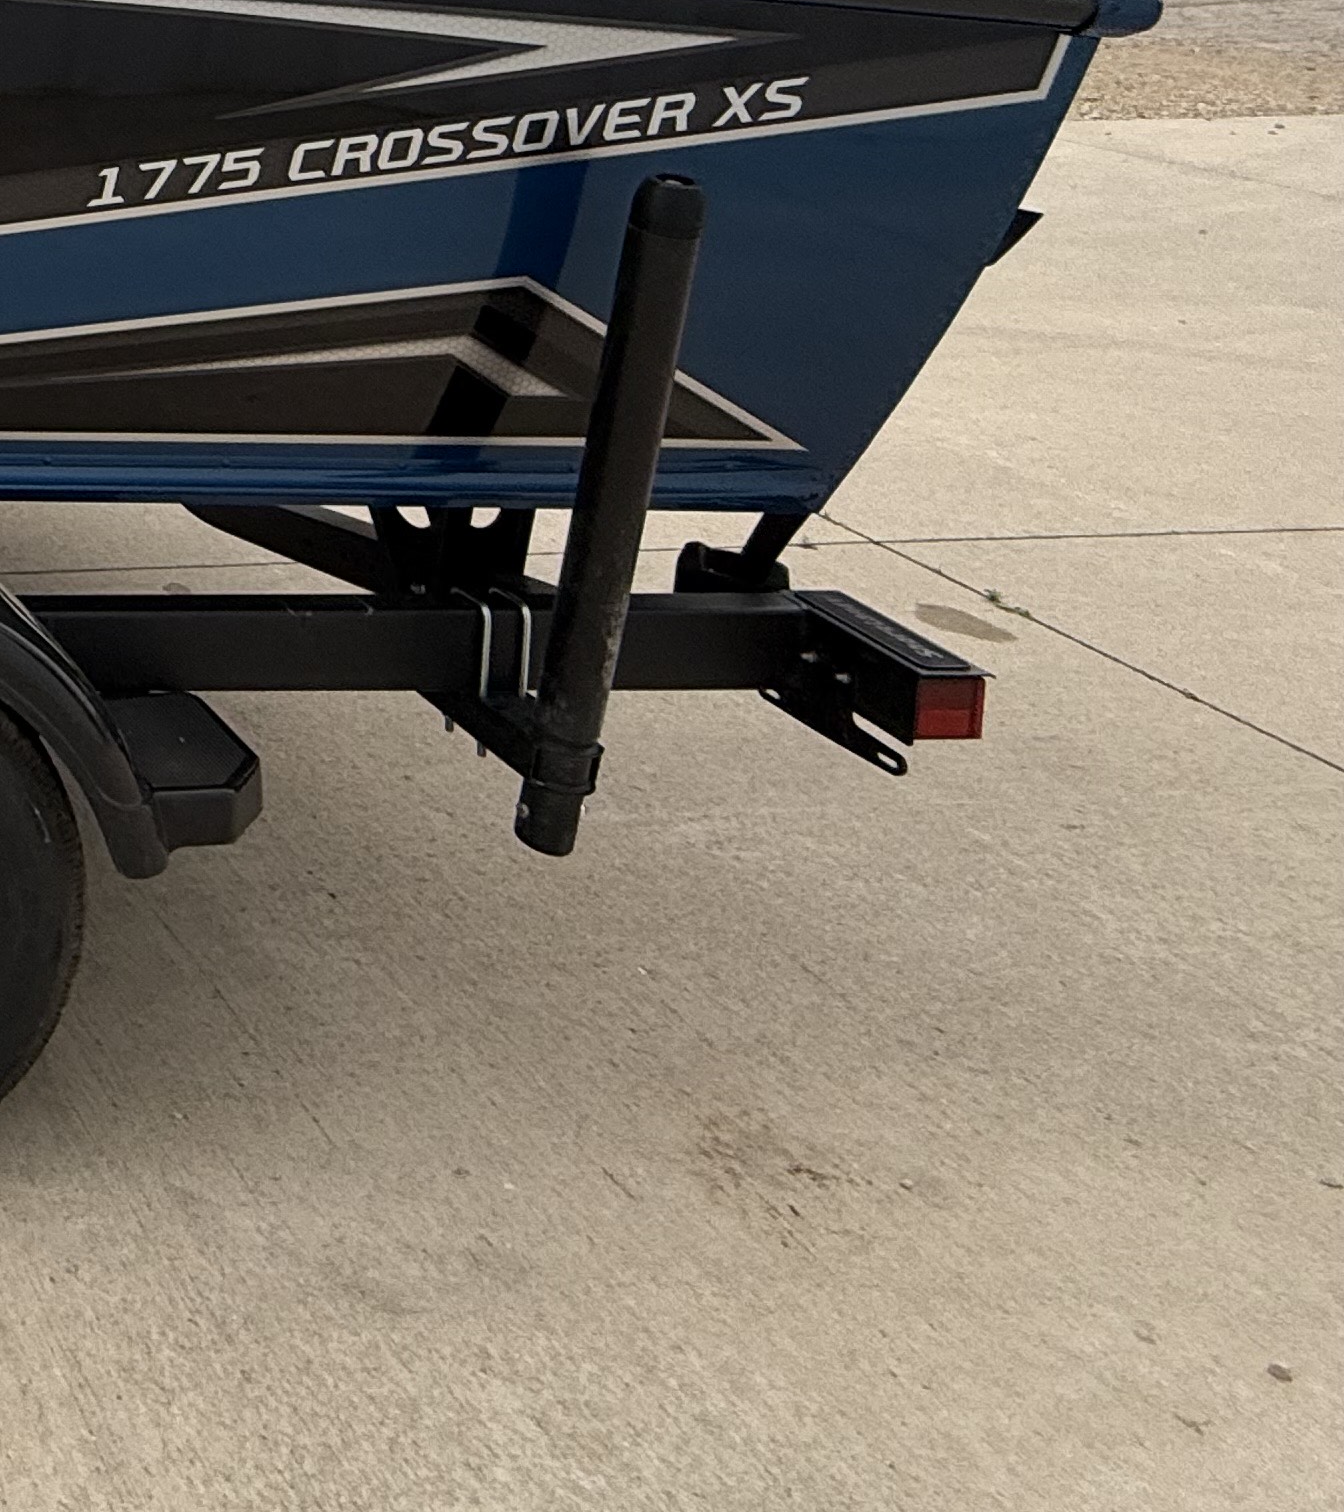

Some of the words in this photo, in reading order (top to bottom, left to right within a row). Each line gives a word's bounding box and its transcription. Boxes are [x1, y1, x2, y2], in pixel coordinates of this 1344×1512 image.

[86, 147, 265, 207] 1775
[288, 92, 697, 181] CROSSOVER
[712, 76, 810, 128] XS
